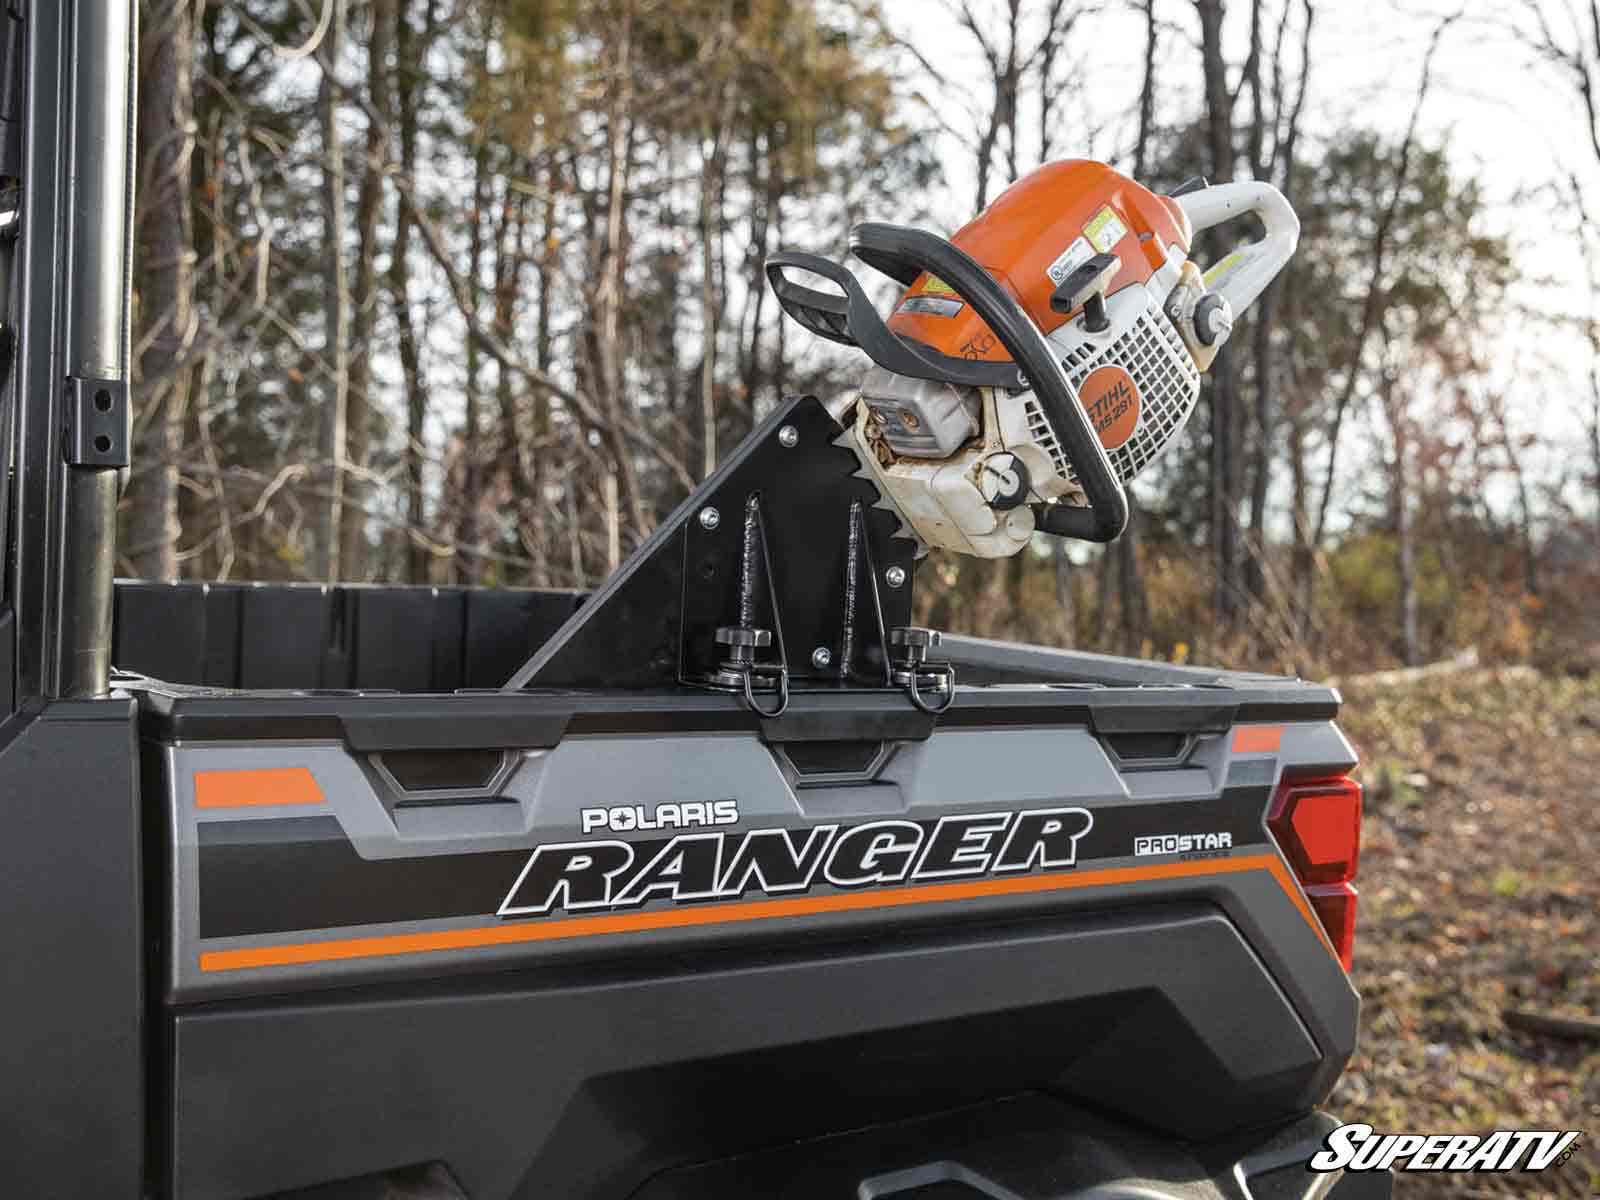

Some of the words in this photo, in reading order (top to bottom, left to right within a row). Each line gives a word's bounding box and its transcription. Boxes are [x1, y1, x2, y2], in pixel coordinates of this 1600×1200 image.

[1087, 380, 1130, 423] STIHL
[581, 800, 739, 833] POLARIS
[496, 807, 1094, 915] RANGER
